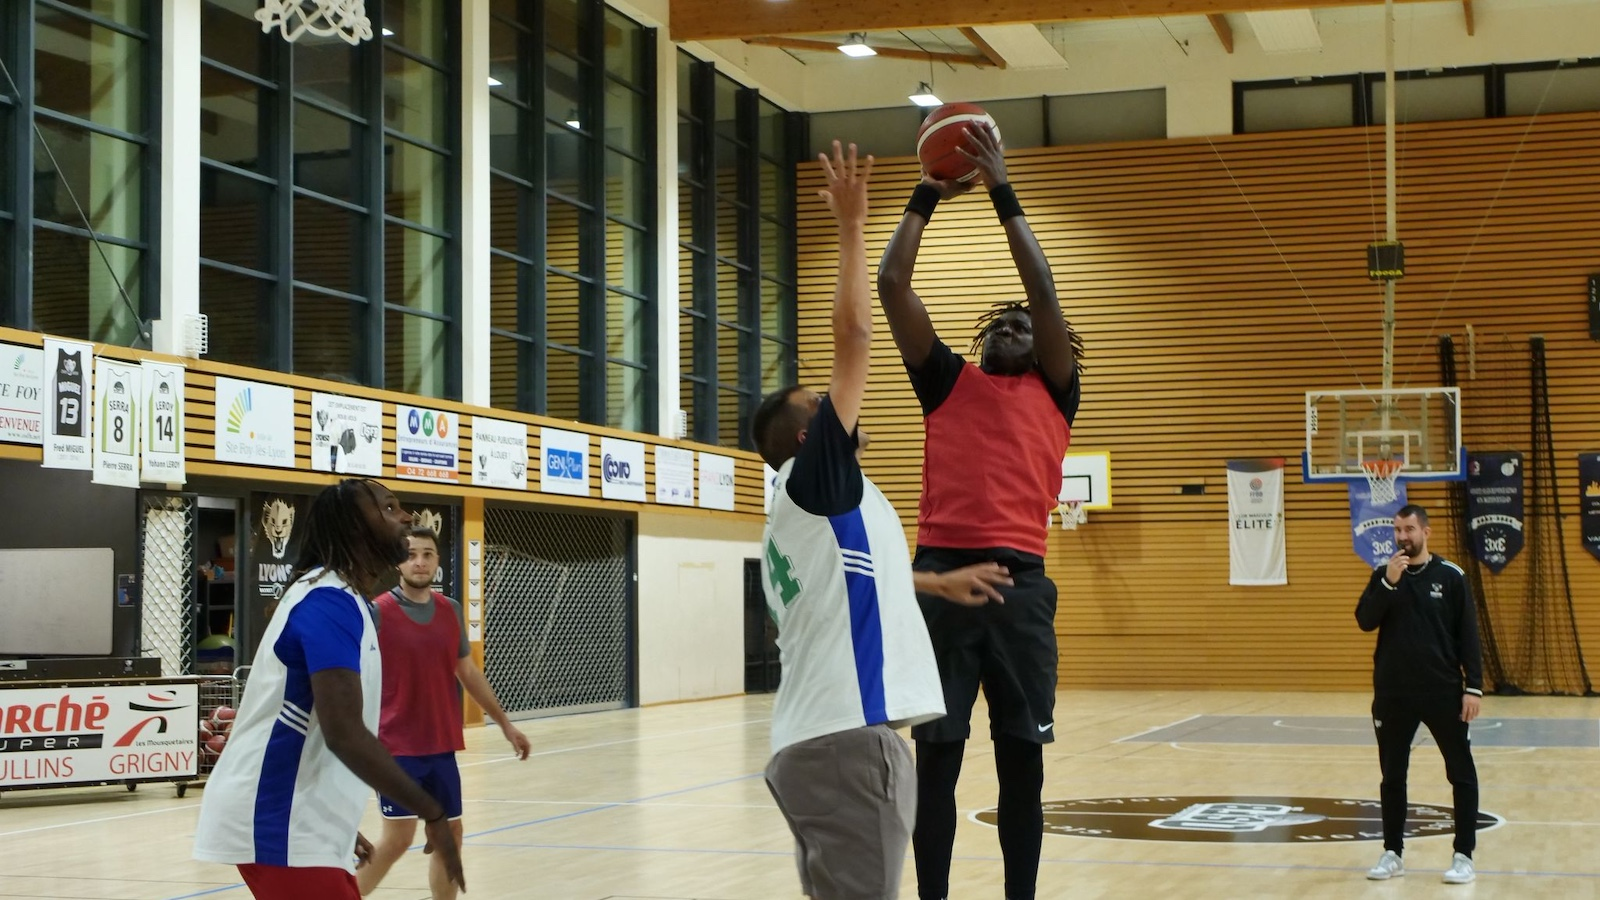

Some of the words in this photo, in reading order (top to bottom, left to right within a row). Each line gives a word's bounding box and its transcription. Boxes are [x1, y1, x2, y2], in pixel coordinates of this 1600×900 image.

[15, 385, 41, 401] FOY
[60, 397, 79, 425] 13
[109, 400, 129, 414] SERRA
[156, 401, 173, 413] LEROY
[113, 415, 124, 443] 8
[156, 415, 173, 442] 14
[102, 460, 117, 470] Pierre
[117, 461, 133, 472] SERRA
[109, 751, 194, 775] GRIGNY
